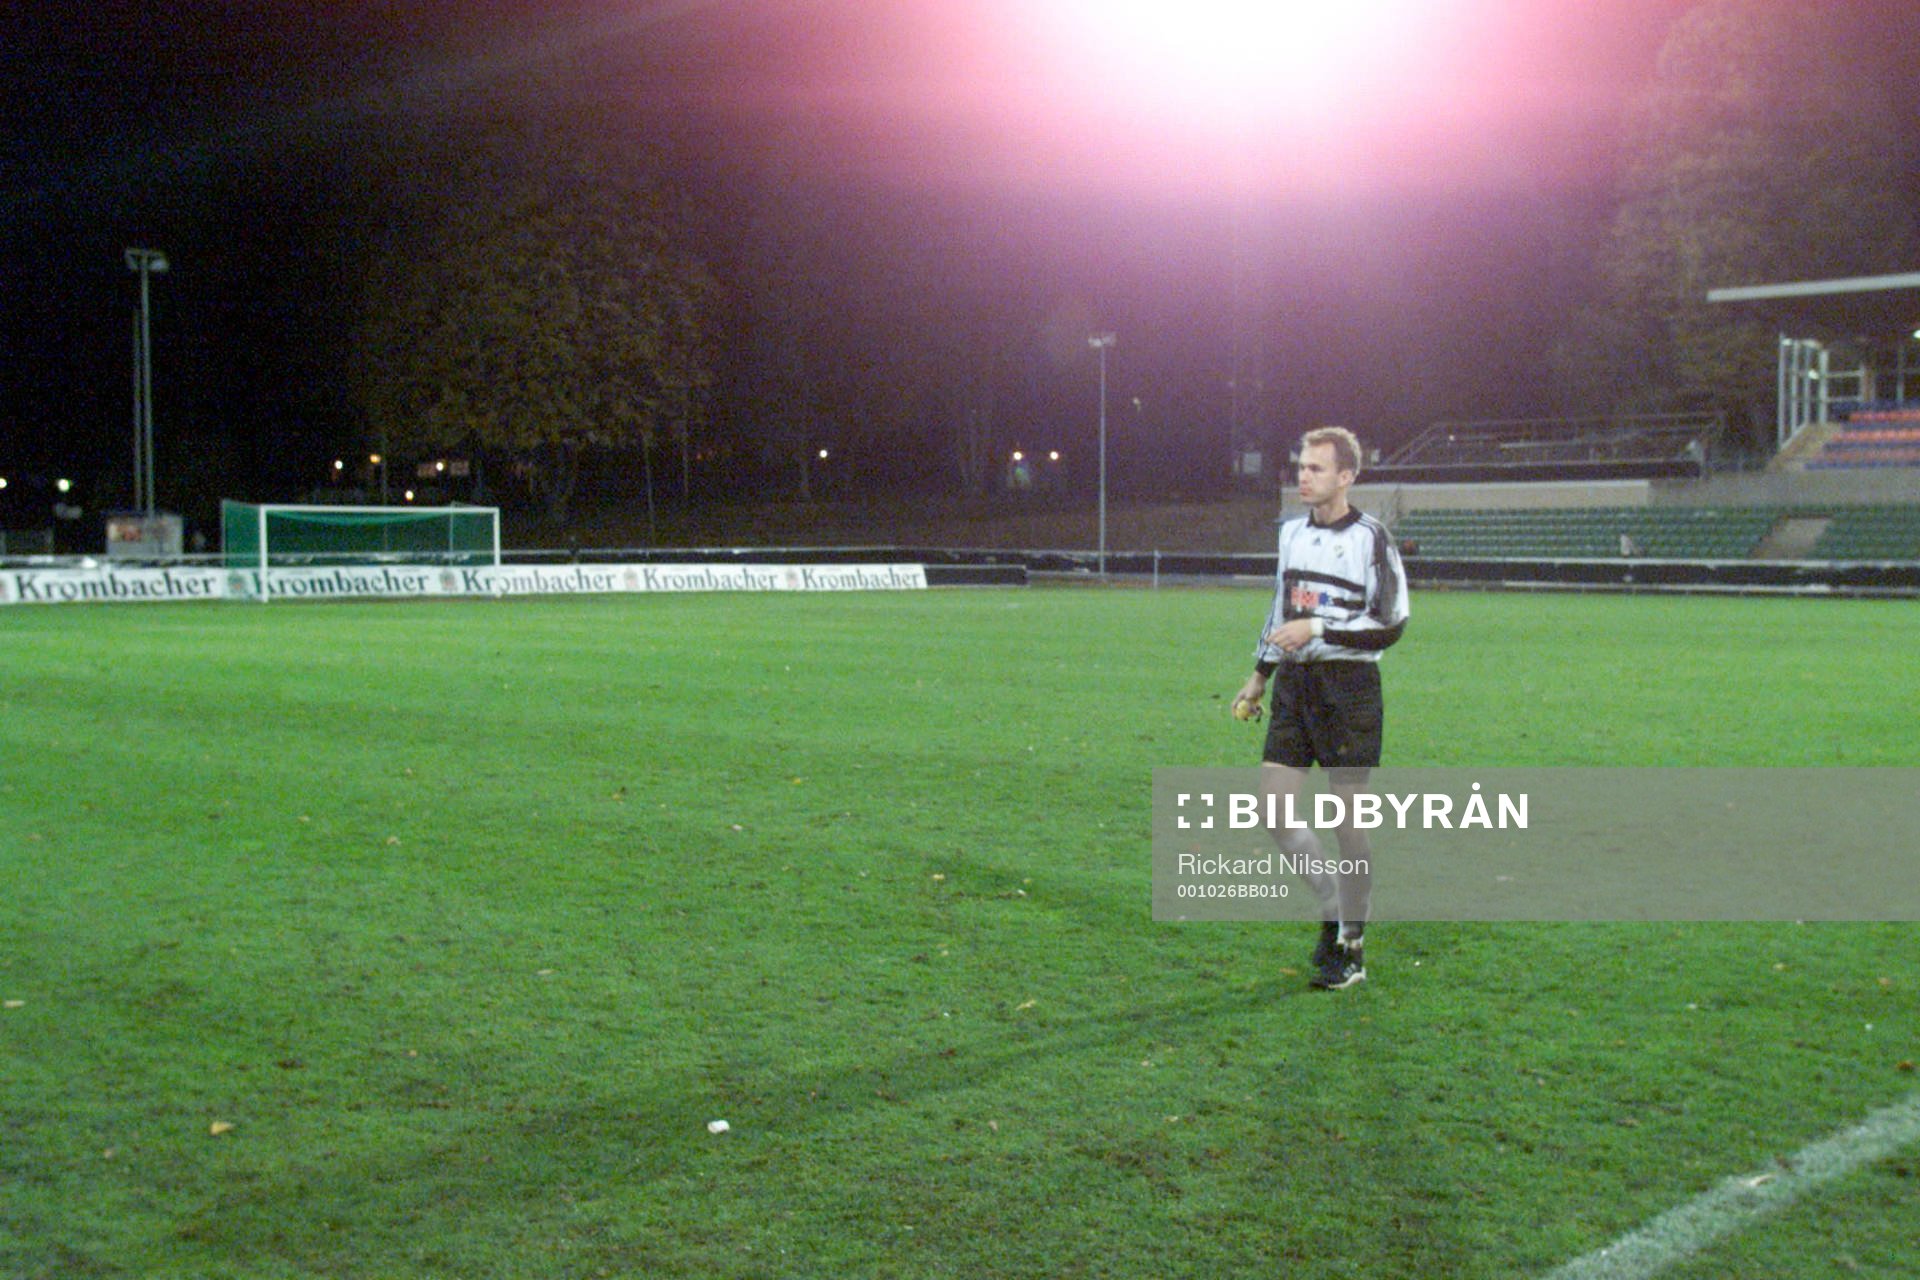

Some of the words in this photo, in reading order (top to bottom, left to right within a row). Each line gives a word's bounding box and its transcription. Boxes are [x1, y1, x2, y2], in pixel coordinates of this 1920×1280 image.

[16, 571, 216, 600] Krombacher
[643, 567, 779, 590] Krombacher
[802, 566, 921, 588] Krombacher
